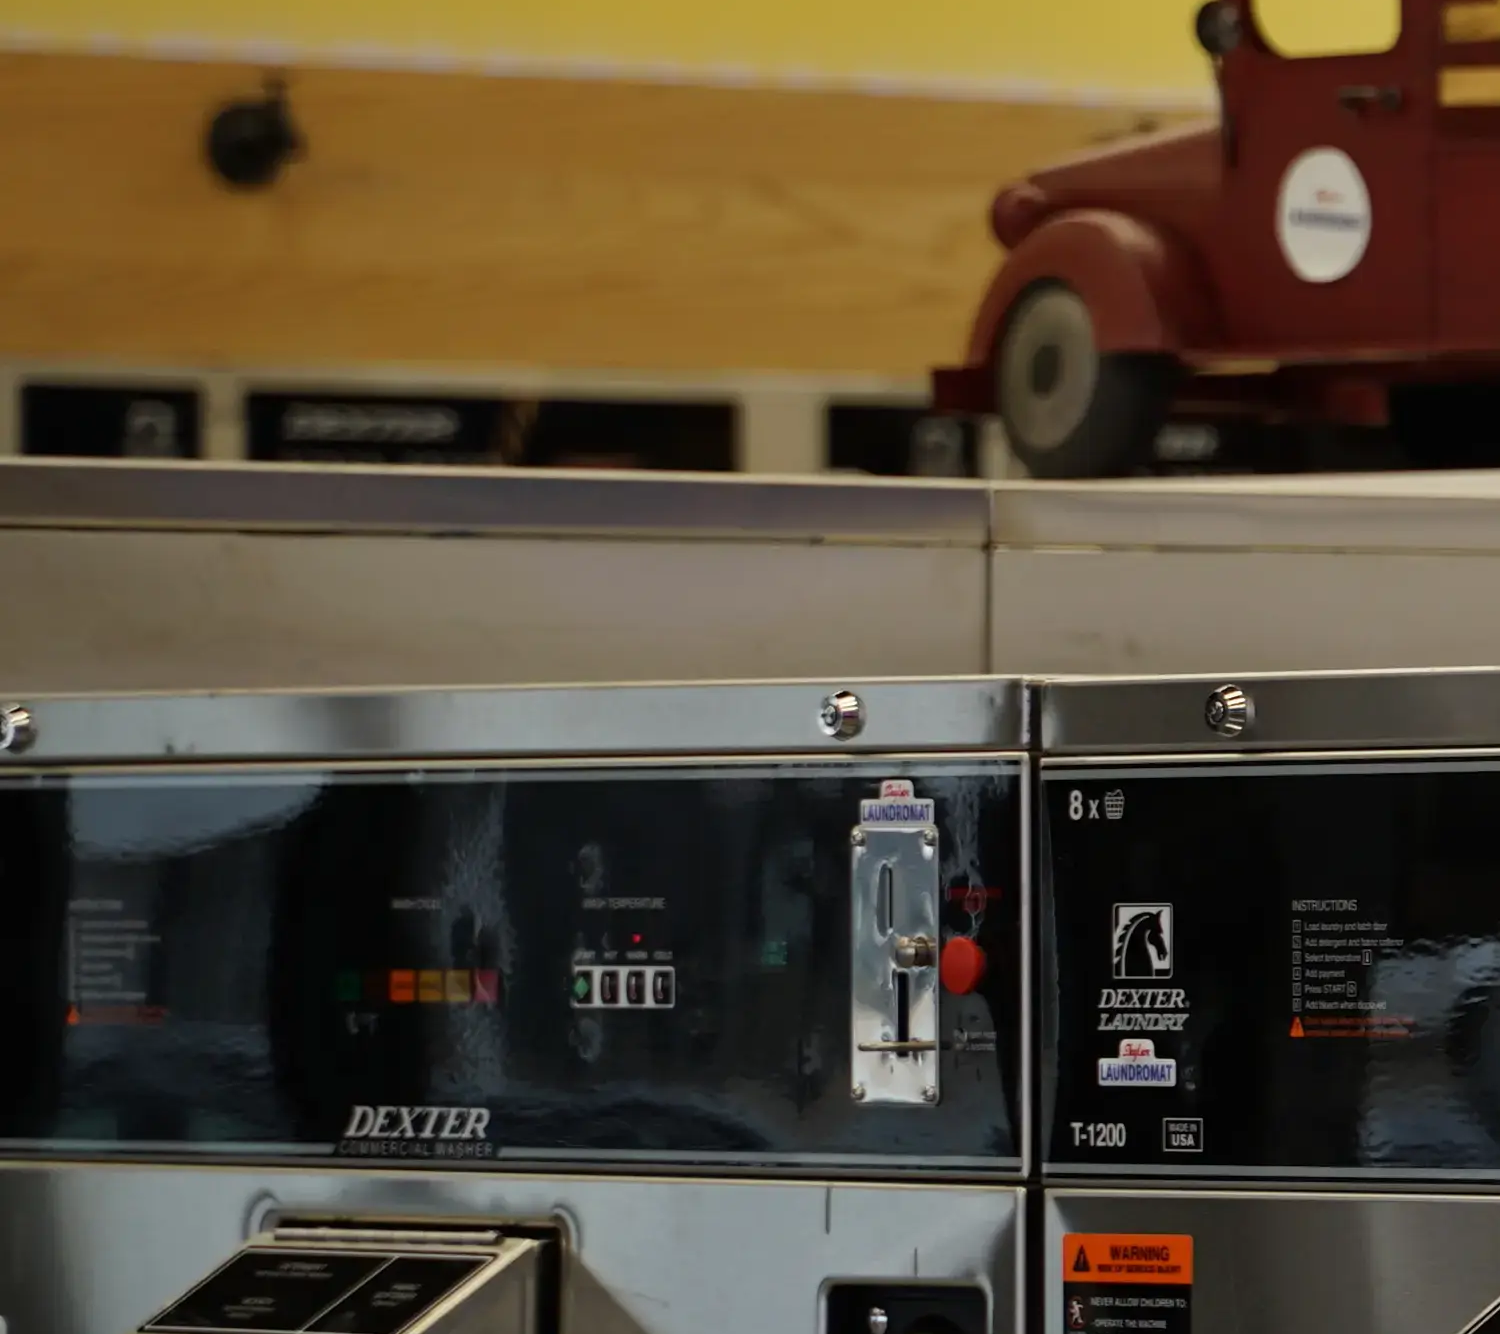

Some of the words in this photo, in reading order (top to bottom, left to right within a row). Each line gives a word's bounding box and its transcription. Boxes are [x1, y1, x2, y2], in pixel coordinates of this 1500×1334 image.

[862, 804, 933, 822] LAUNDROMAT
[1069, 789, 1083, 821] 8
[1291, 899, 1358, 912] INSTRUCTIONS
[1098, 988, 1185, 1010] DEXTER
[1098, 1012, 1190, 1032] LAUNDRY
[1101, 1063, 1172, 1082] LAUNDROMAT
[344, 1106, 491, 1139] DEXTER
[1071, 1122, 1126, 1147] T-1200
[1171, 1133, 1195, 1148] USA
[1110, 1244, 1170, 1261] WARNING
